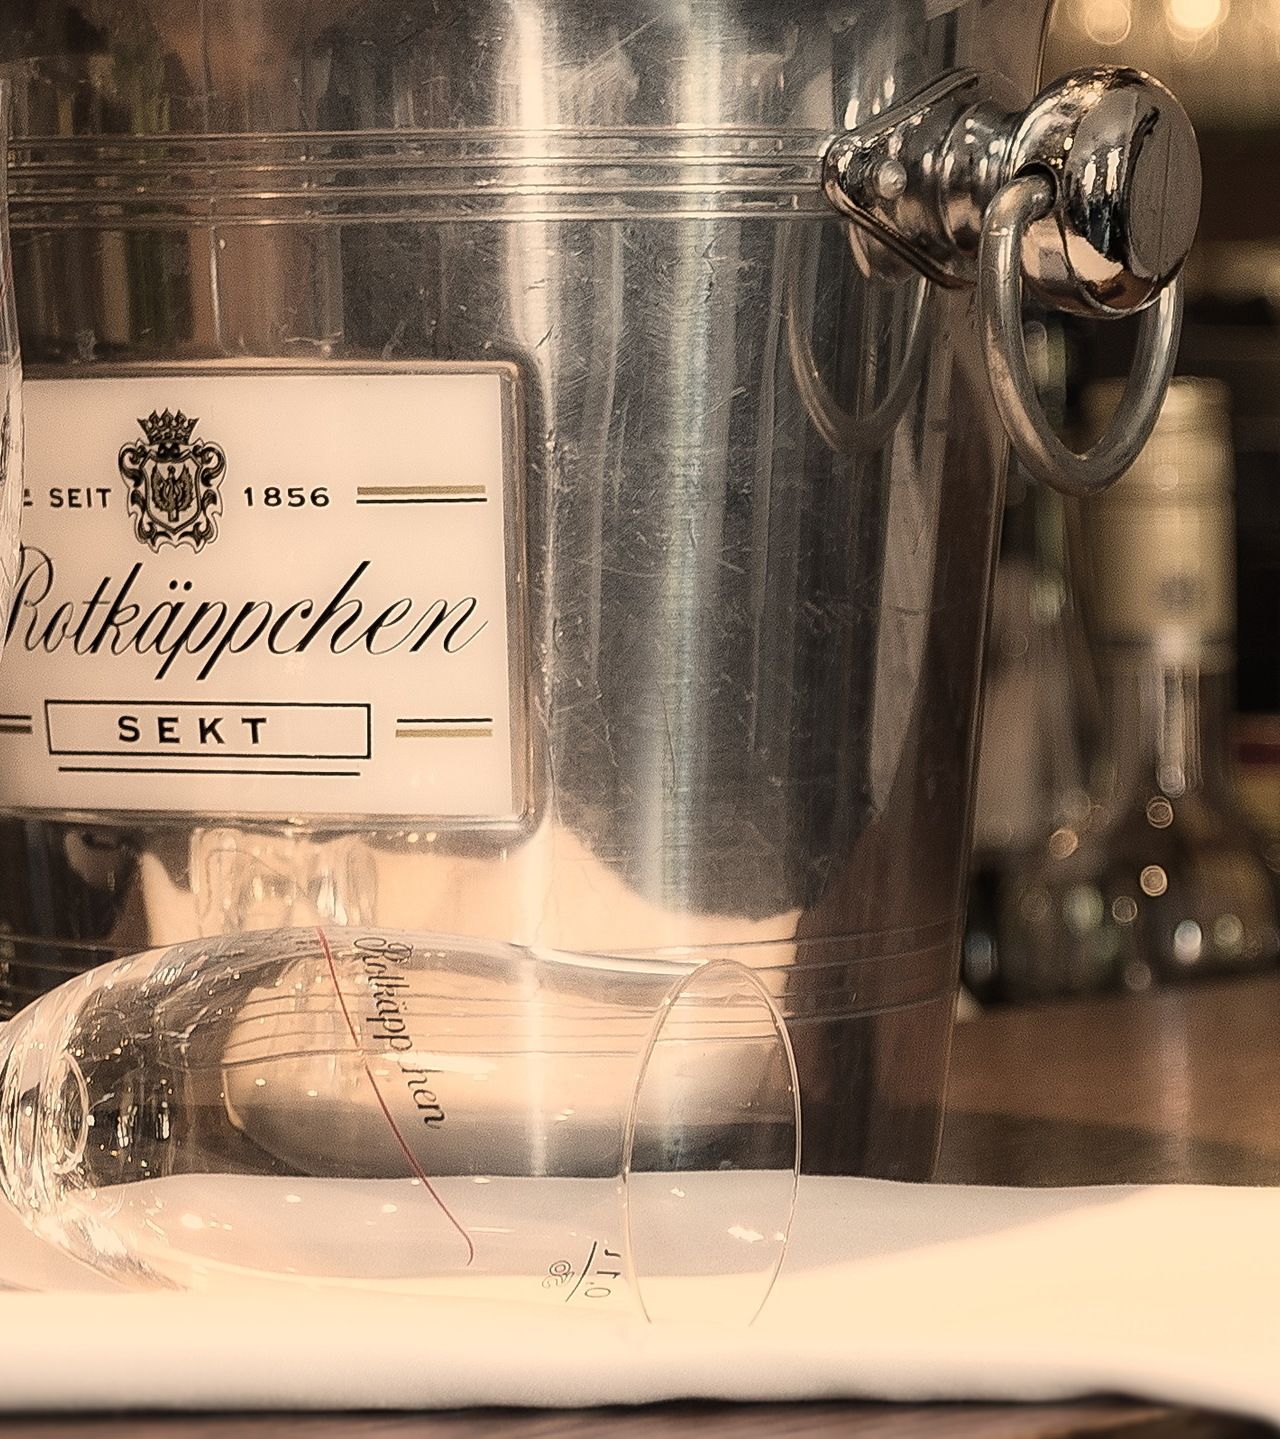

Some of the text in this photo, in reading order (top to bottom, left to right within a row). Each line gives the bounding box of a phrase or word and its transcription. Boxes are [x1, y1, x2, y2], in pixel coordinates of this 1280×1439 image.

[49, 486, 331, 509] SEIT 1856
[4, 544, 488, 681] Rotkäppchen
[118, 715, 268, 745] SEKT
